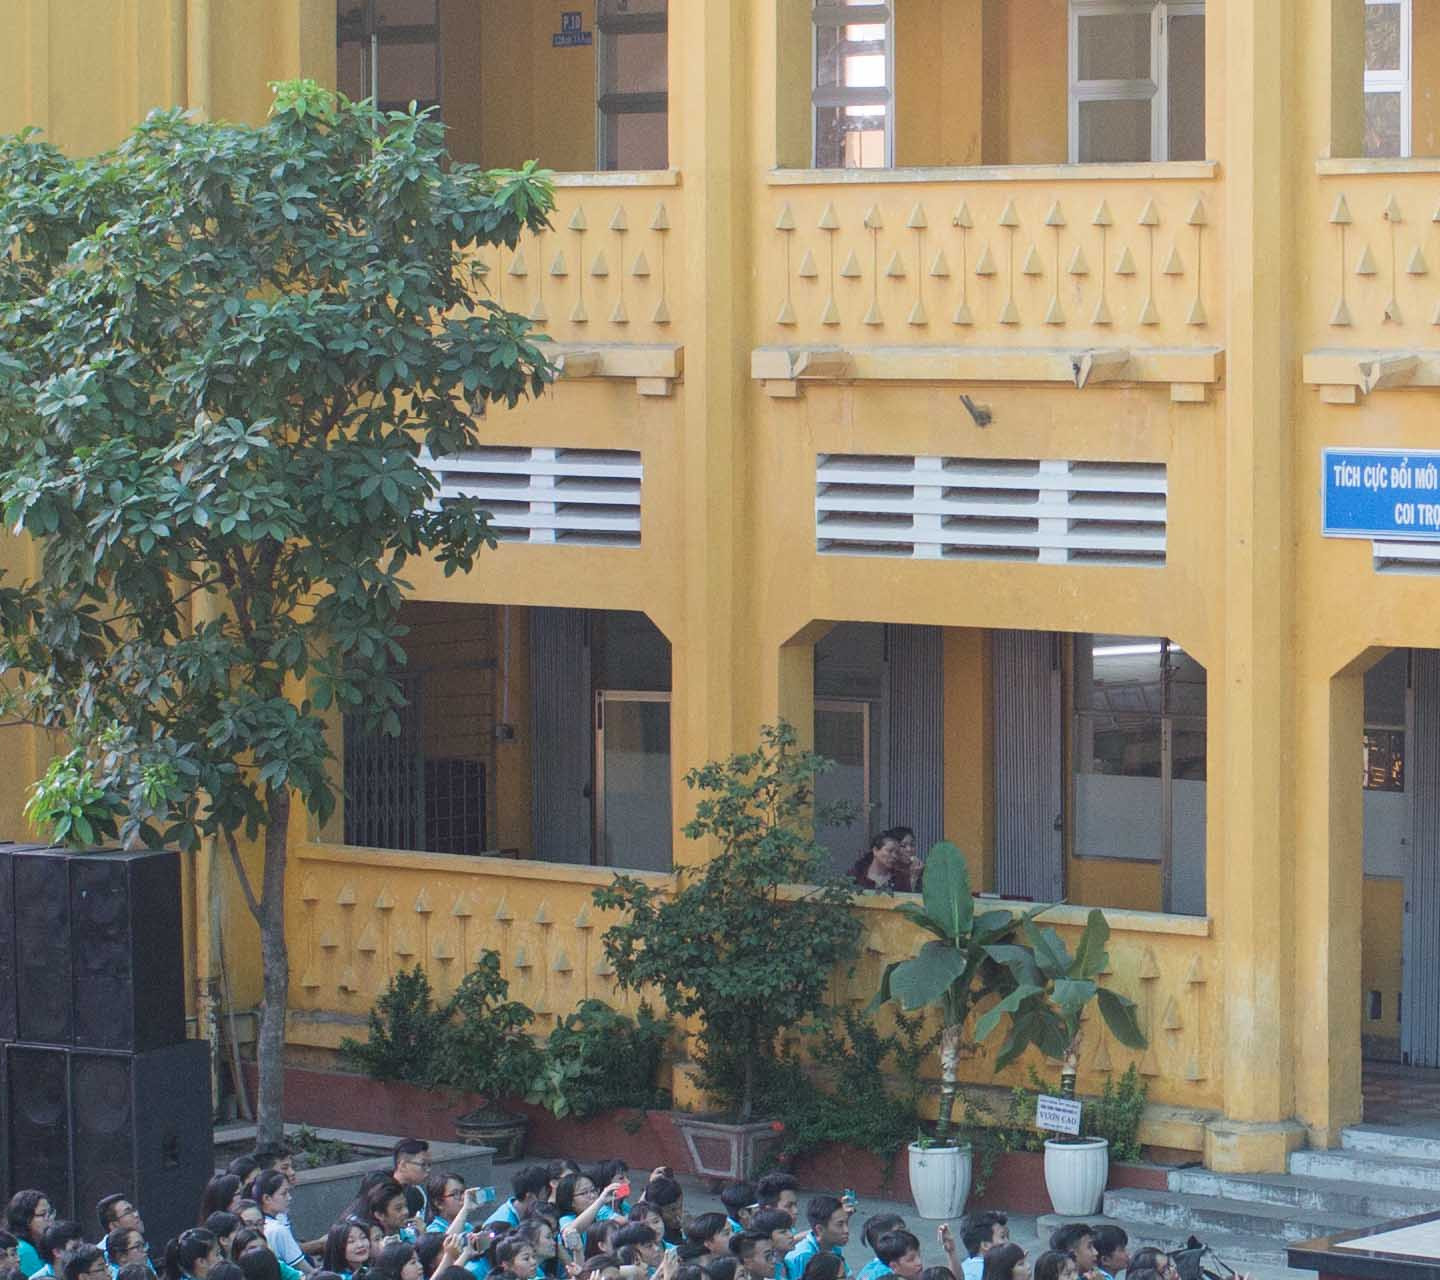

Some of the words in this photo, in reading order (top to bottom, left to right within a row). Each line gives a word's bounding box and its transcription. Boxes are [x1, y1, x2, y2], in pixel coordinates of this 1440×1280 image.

[1333, 460, 1361, 488] TÍCH
[1363, 463, 1388, 493] CỰC
[1390, 456, 1412, 490] ĐỔI
[1414, 464, 1439, 490] MỚI
[1394, 503, 1415, 526] COI
